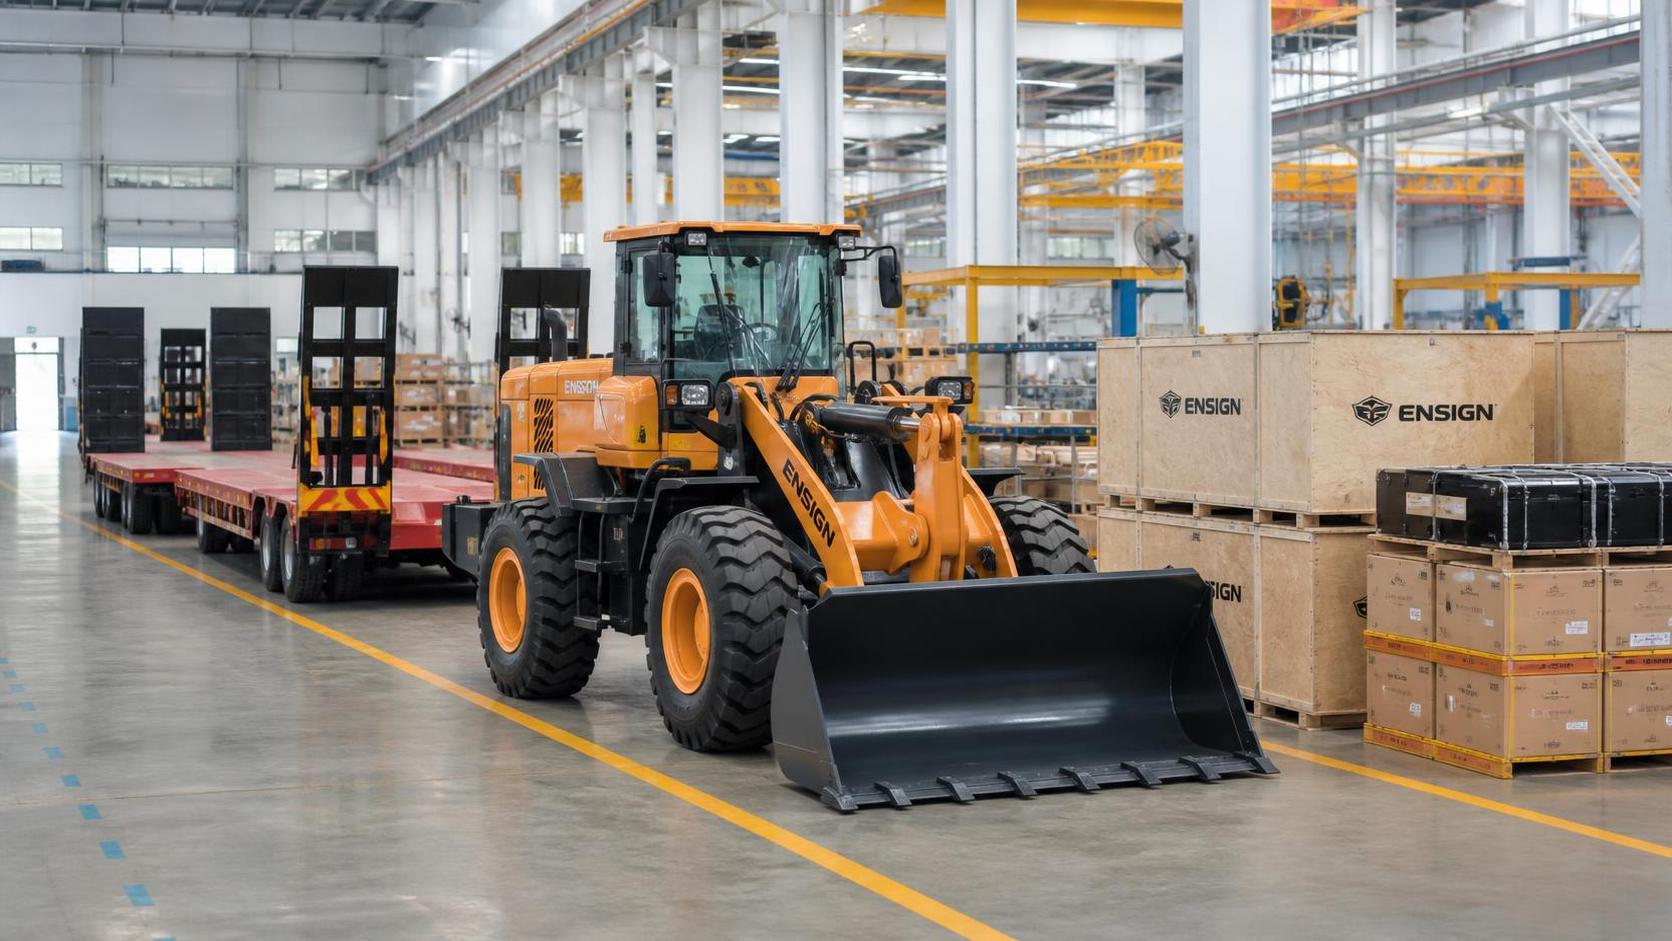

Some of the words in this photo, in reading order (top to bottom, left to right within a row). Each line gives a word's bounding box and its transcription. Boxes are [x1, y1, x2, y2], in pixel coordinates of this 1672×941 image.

[1184, 398, 1242, 416] ENSIGN
[1398, 404, 1493, 422] ENSIGN
[782, 458, 836, 548] ENSIGN
[1205, 580, 1242, 603] SIGN
